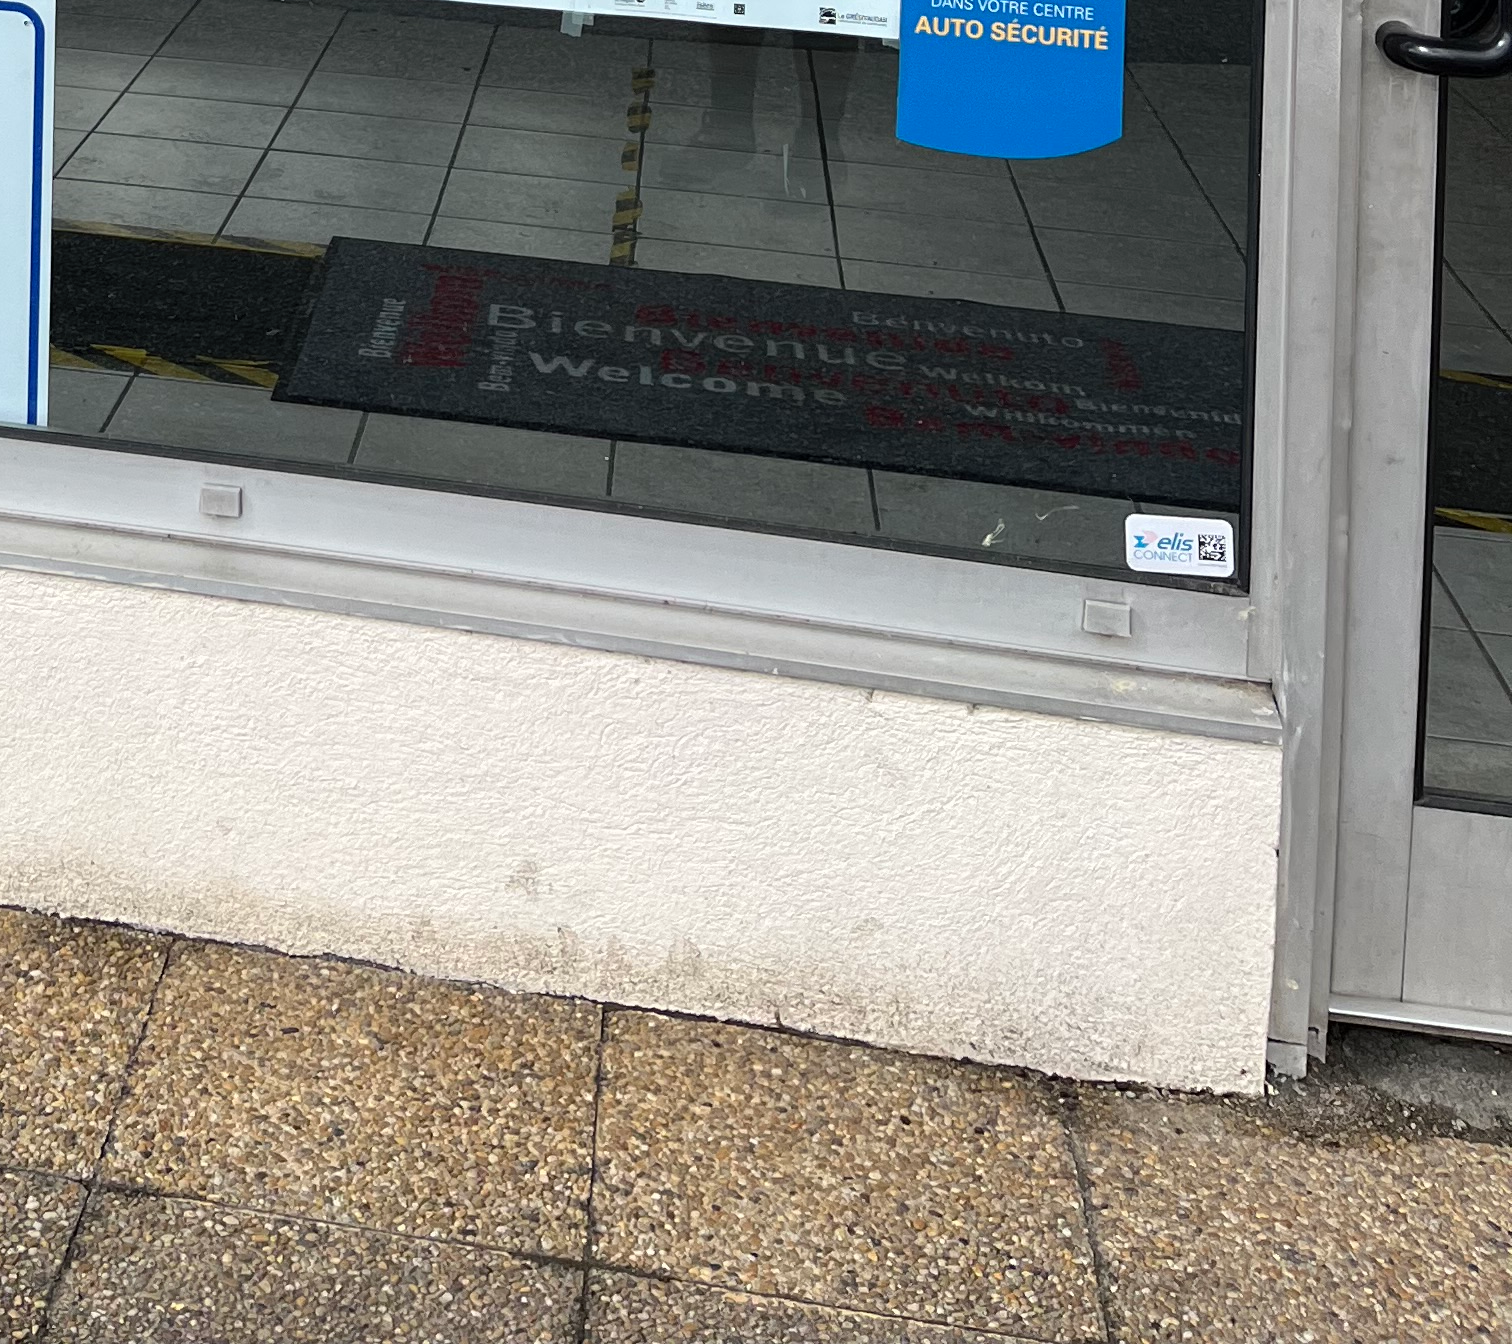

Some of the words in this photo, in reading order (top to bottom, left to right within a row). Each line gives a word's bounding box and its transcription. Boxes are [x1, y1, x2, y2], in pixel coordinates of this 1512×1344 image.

[1033, 2, 1095, 21] CENTRE
[914, 15, 984, 39] AUTO
[990, 19, 1109, 51] SÉCURITÉ
[488, 303, 909, 372] Bienvenue
[851, 310, 1085, 350] Benvenuto
[528, 350, 848, 407] Welcome
[1133, 550, 1193, 563] CONNECT
[1157, 532, 1194, 551] elis
